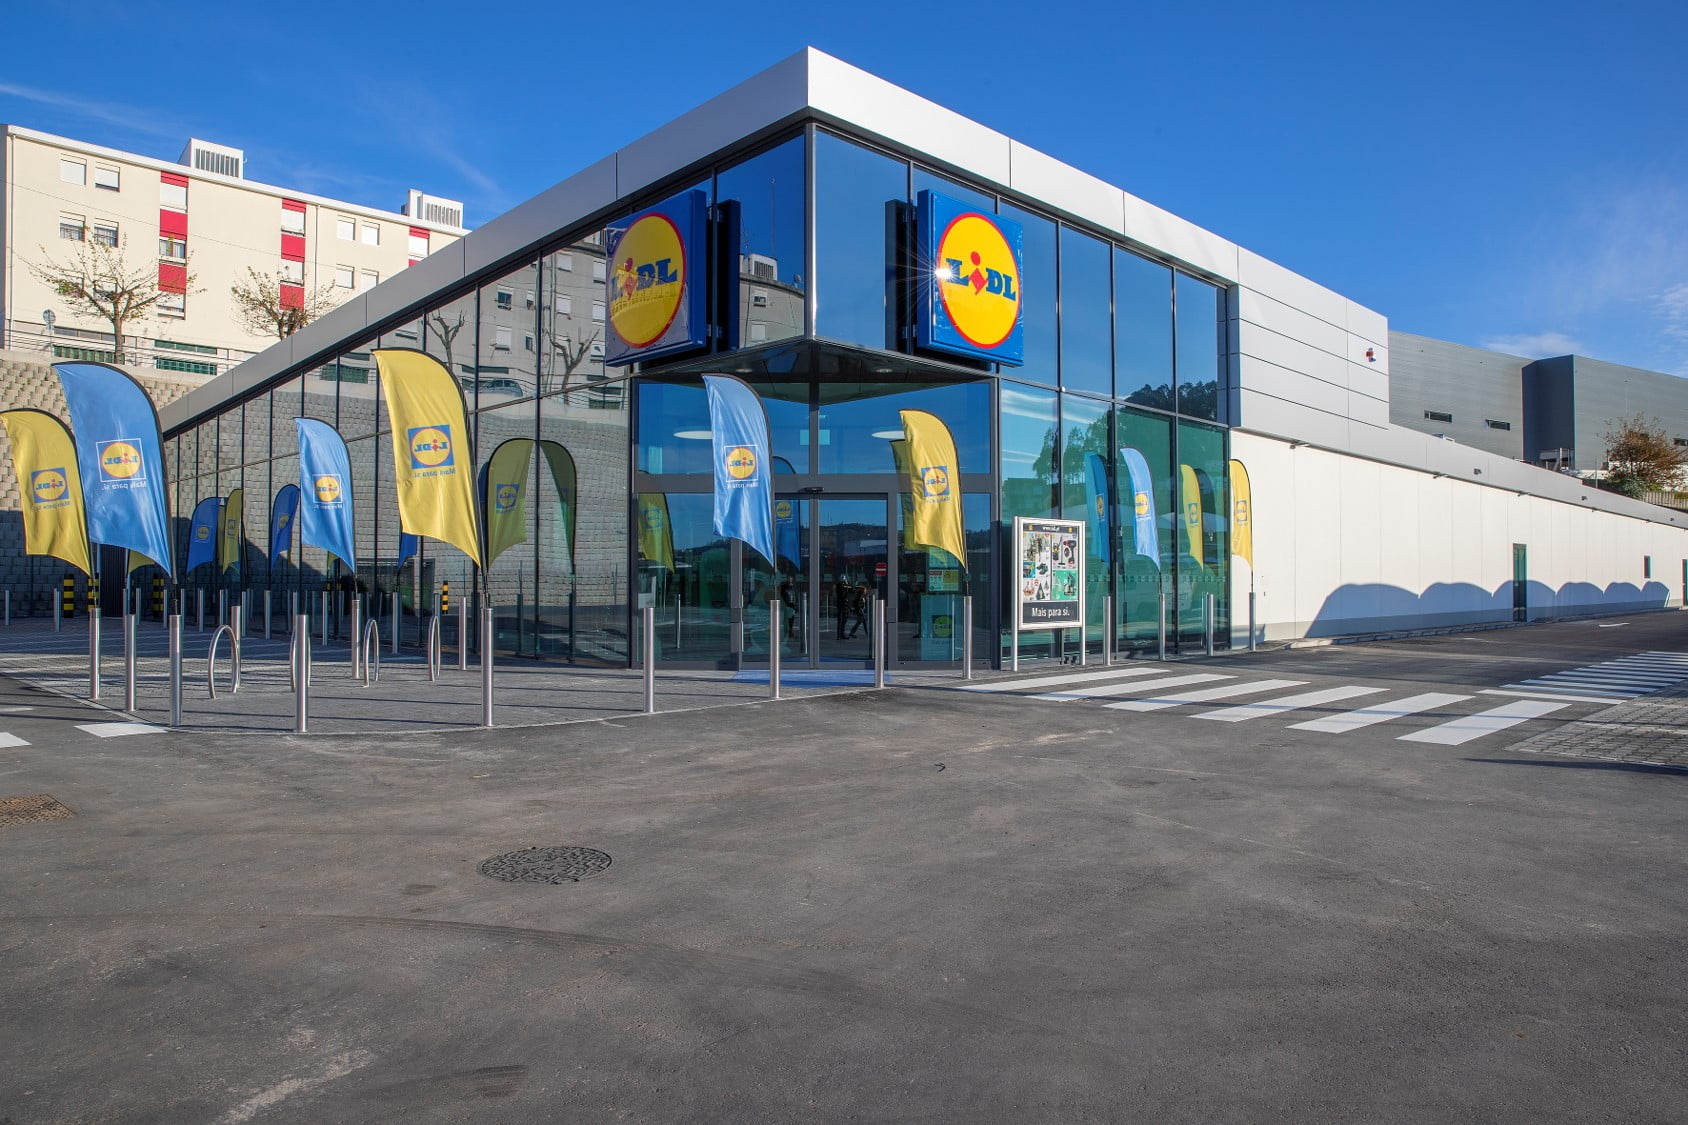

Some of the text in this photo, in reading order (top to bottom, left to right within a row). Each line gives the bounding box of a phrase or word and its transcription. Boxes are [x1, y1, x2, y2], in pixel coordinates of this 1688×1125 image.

[1031, 606, 1070, 619] Mais para si.
